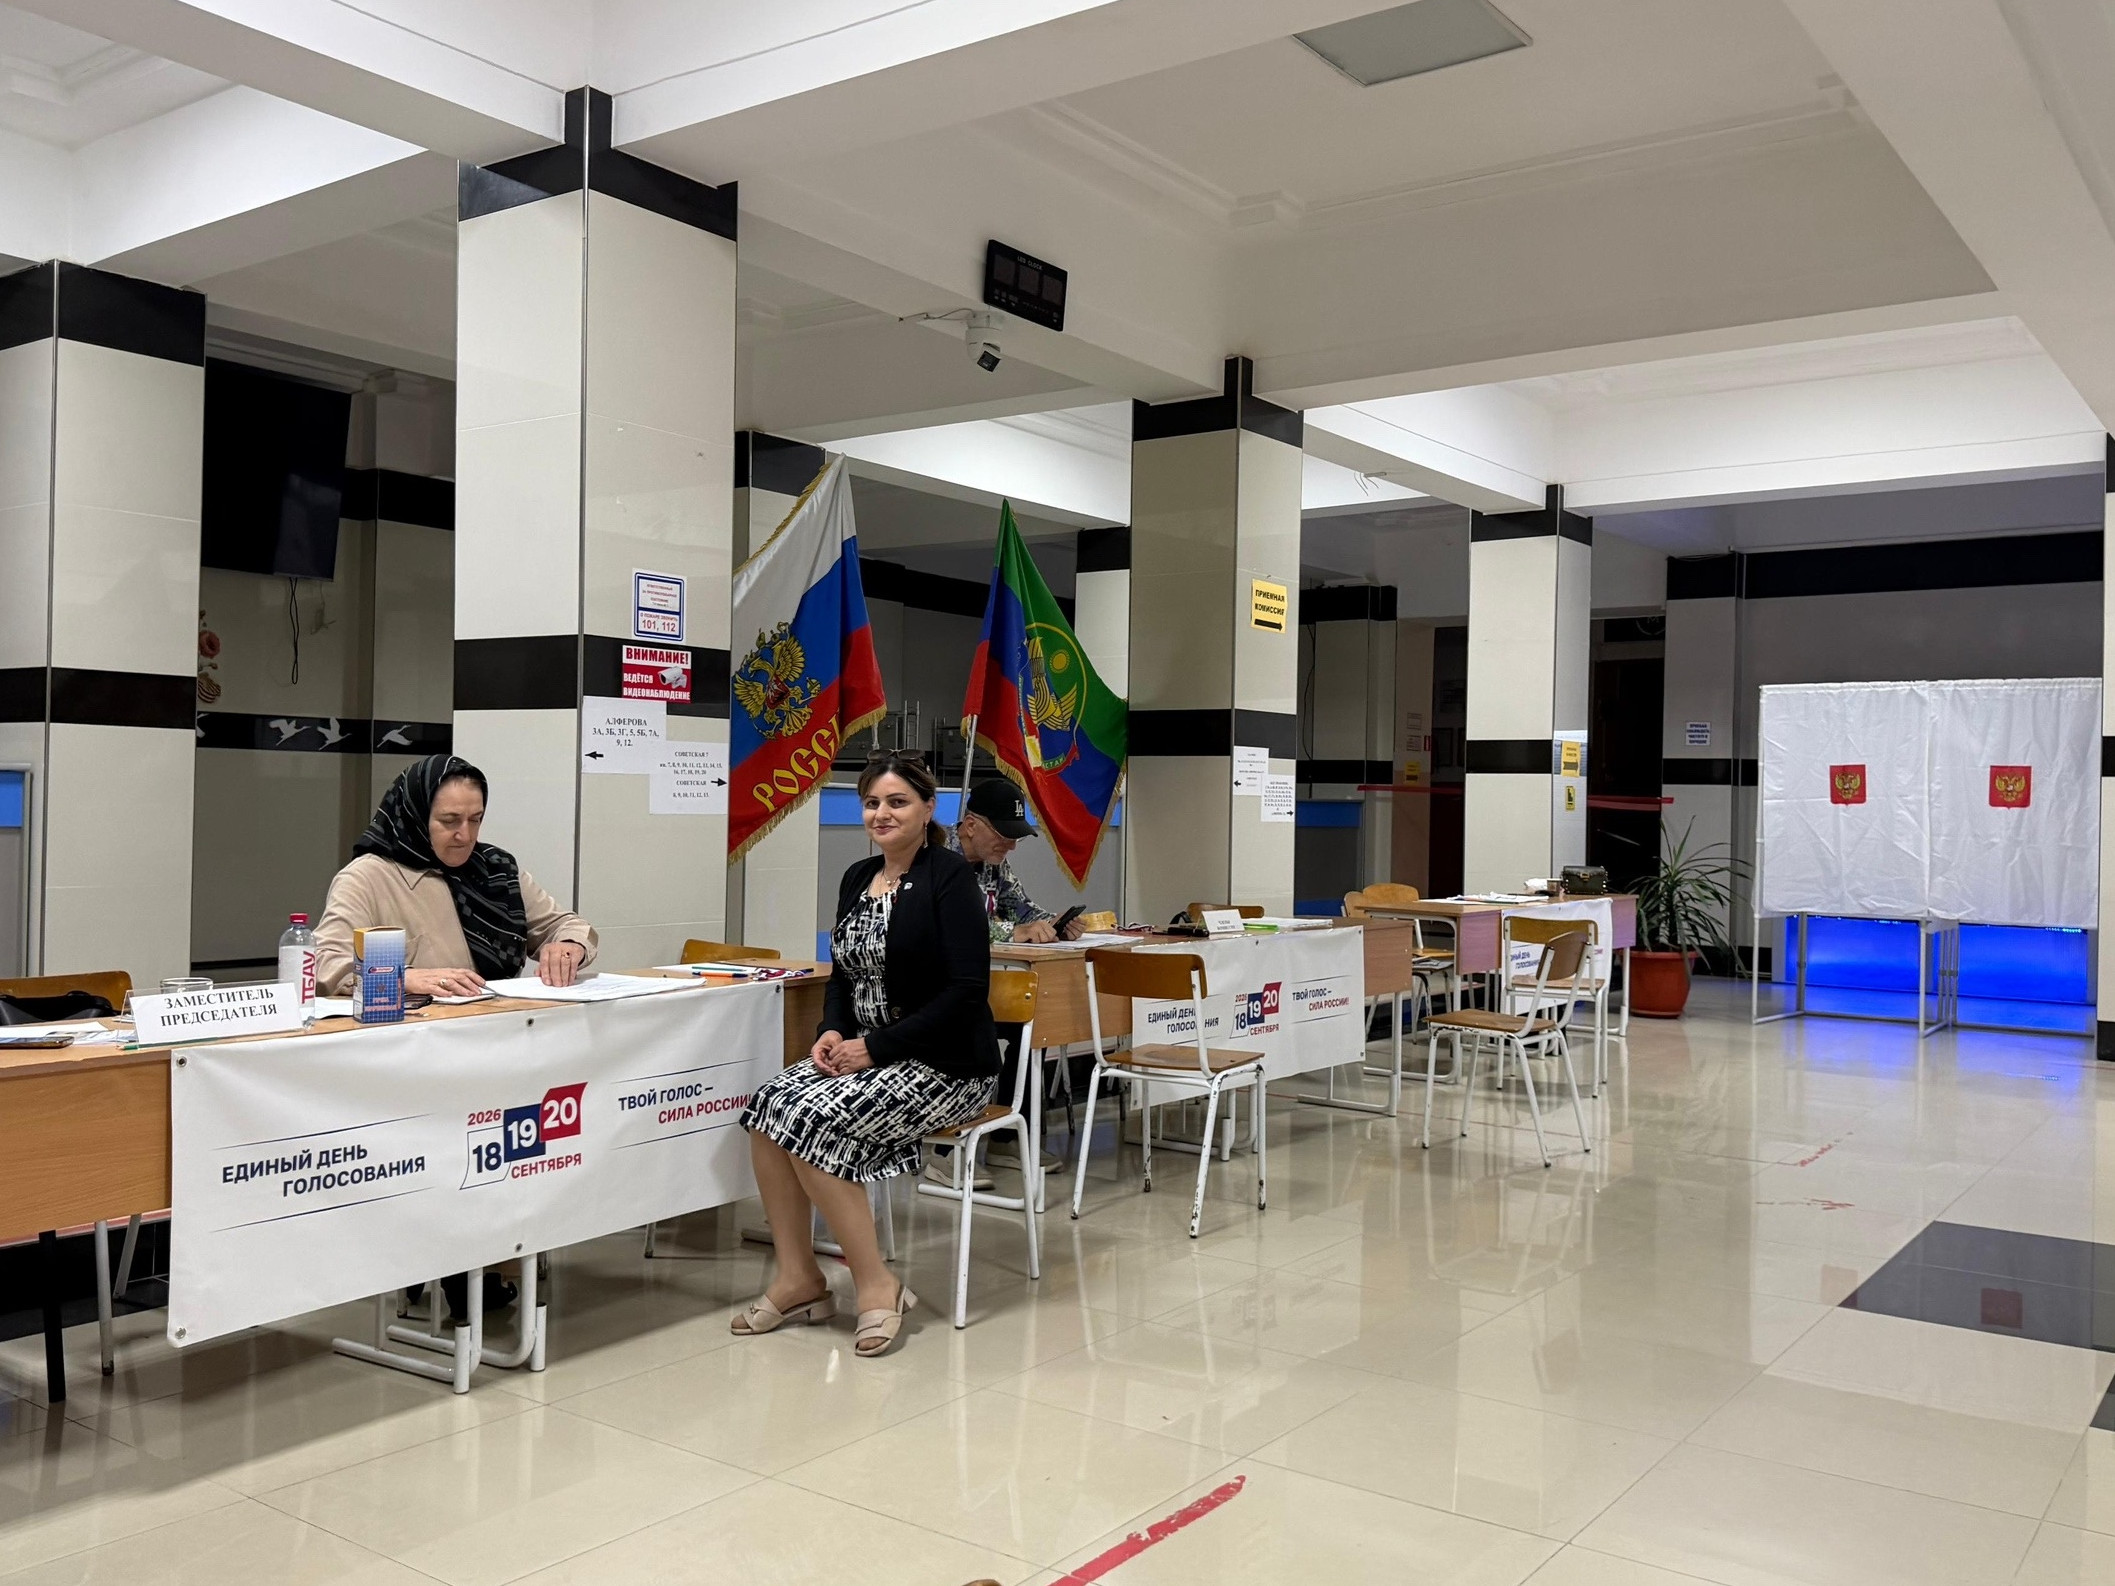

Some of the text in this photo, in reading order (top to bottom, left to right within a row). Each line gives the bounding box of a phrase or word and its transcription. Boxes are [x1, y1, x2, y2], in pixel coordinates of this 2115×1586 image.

[1255, 589, 1285, 602] ПРИЕМНАЯ
[1255, 602, 1284, 615] КОМИССИЯ
[642, 620, 676, 632] 101, 112
[626, 648, 688, 664] ВНИМАНИЕ!
[623, 673, 653, 684] ВЕДЁТСЯ
[623, 687, 690, 700] ВИДЕОНАБЛЮДЕНИЕ
[606, 718, 647, 726] АЛФЕРОВА
[1015, 800, 1024, 816] LA
[164, 988, 274, 1009] ЗАМЕСТИТЕЛЬ
[1292, 988, 1308, 1000] ТВОЙ
[1309, 988, 1326, 998] ГОЛОС
[1235, 989, 1278, 1030] 18 19 20
[1309, 997, 1349, 1011] СИЛА РОССИИ!
[160, 1004, 277, 1026] ПРЕДСЕДАТЕЛЯ
[1148, 1007, 1196, 1024] ЕДИНЫЙ ДЕН
[1250, 1023, 1279, 1035] СЕНТЯБРЯ
[618, 1088, 657, 1111] ТВОЙ
[660, 1083, 702, 1103] ГОЛОС
[467, 1108, 502, 1126] 2026
[658, 1104, 693, 1124] СИЛА
[472, 1096, 578, 1174] 18 19 20
[222, 1144, 368, 1184] ЕДИНЫЙ ДЕНЬ
[511, 1153, 582, 1179] СЕНТЯБРЯ
[283, 1156, 426, 1197] ГОЛОСОВАНИЯ
